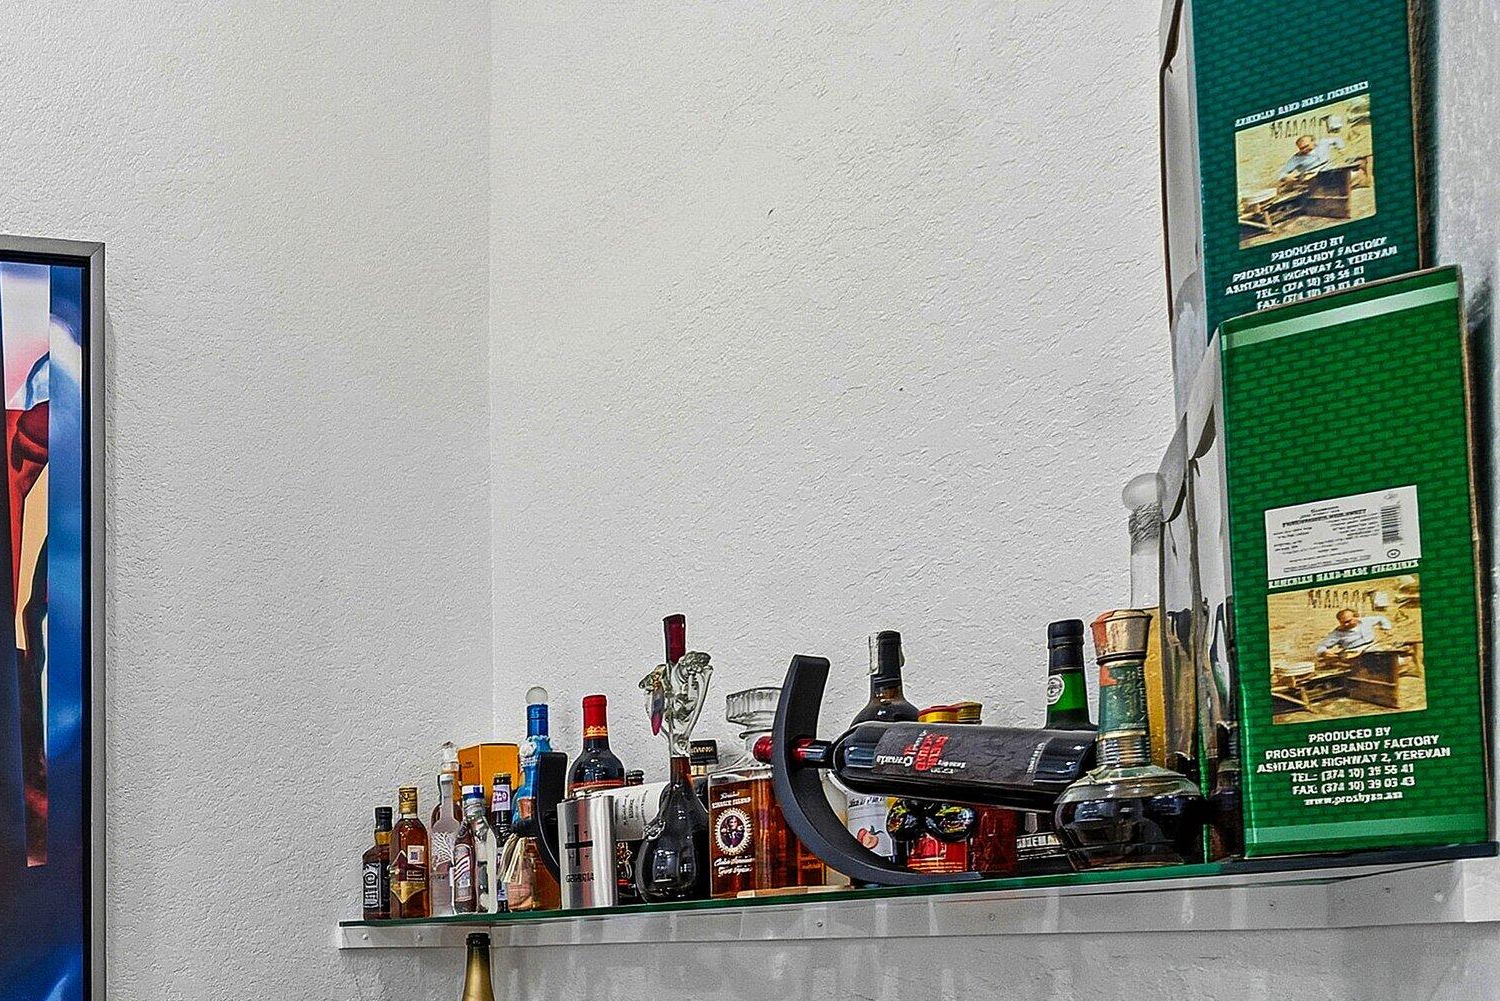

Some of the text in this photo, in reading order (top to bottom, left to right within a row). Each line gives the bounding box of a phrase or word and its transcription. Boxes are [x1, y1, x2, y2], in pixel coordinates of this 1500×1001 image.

[1271, 235, 1345, 262] PRODUCED BY
[1292, 250, 1335, 269] BRANDY
[1338, 236, 1388, 256] FACTORY
[1283, 260, 1333, 281] HIGHWAY
[1308, 726, 1392, 743] PRODUCED BY
[1256, 760, 1319, 773] ASHTARAK
[1321, 753, 1377, 767] HIGHWAY
[1395, 747, 1451, 761] YEREVAN
[1265, 735, 1440, 760] PROSHYAN BRANDY FACTORY
[1304, 791, 1404, 806] www.proshyan.am
